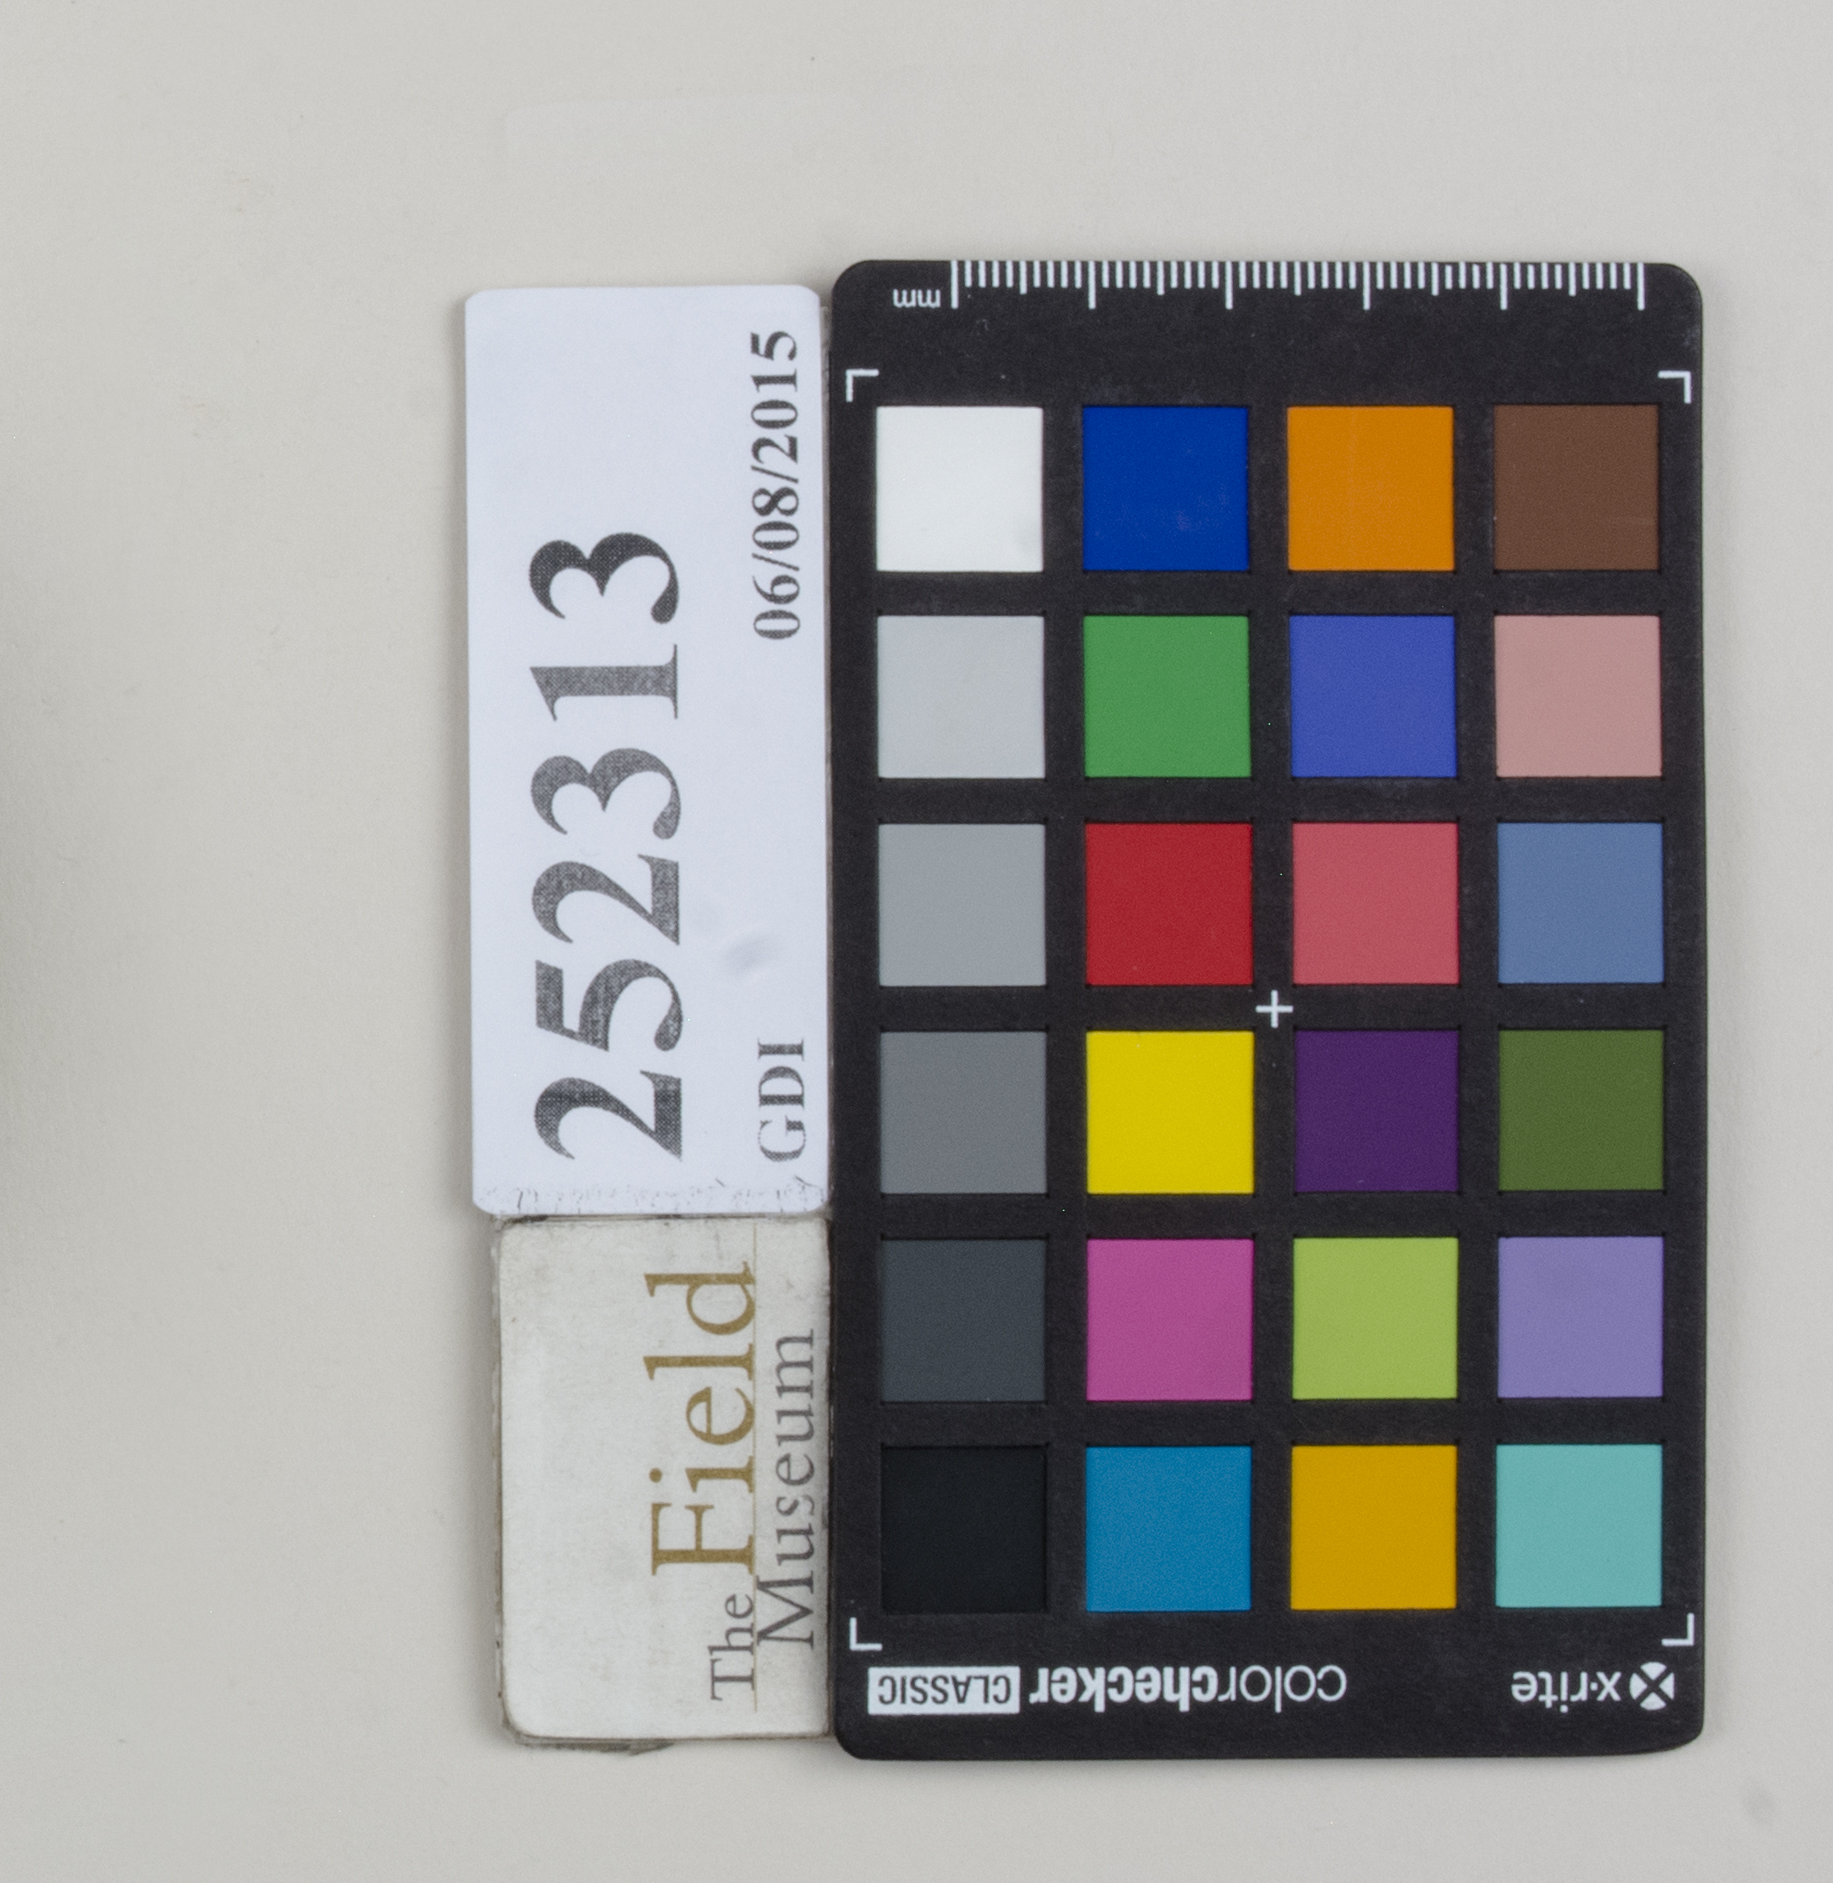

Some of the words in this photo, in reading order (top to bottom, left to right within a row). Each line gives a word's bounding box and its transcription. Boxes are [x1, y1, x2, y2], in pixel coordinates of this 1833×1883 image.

[892, 288, 941, 309] mm
[750, 330, 801, 640] 06/08/2015
[528, 531, 684, 1159] 252313
[758, 1041, 805, 1162] GDI
[643, 1261, 756, 1576] Field
[757, 1329, 815, 1653] Museum
[707, 1594, 755, 1702] The
[877, 1673, 1013, 1706] CLASSIC
[1028, 1664, 1348, 1714] colorchecker
